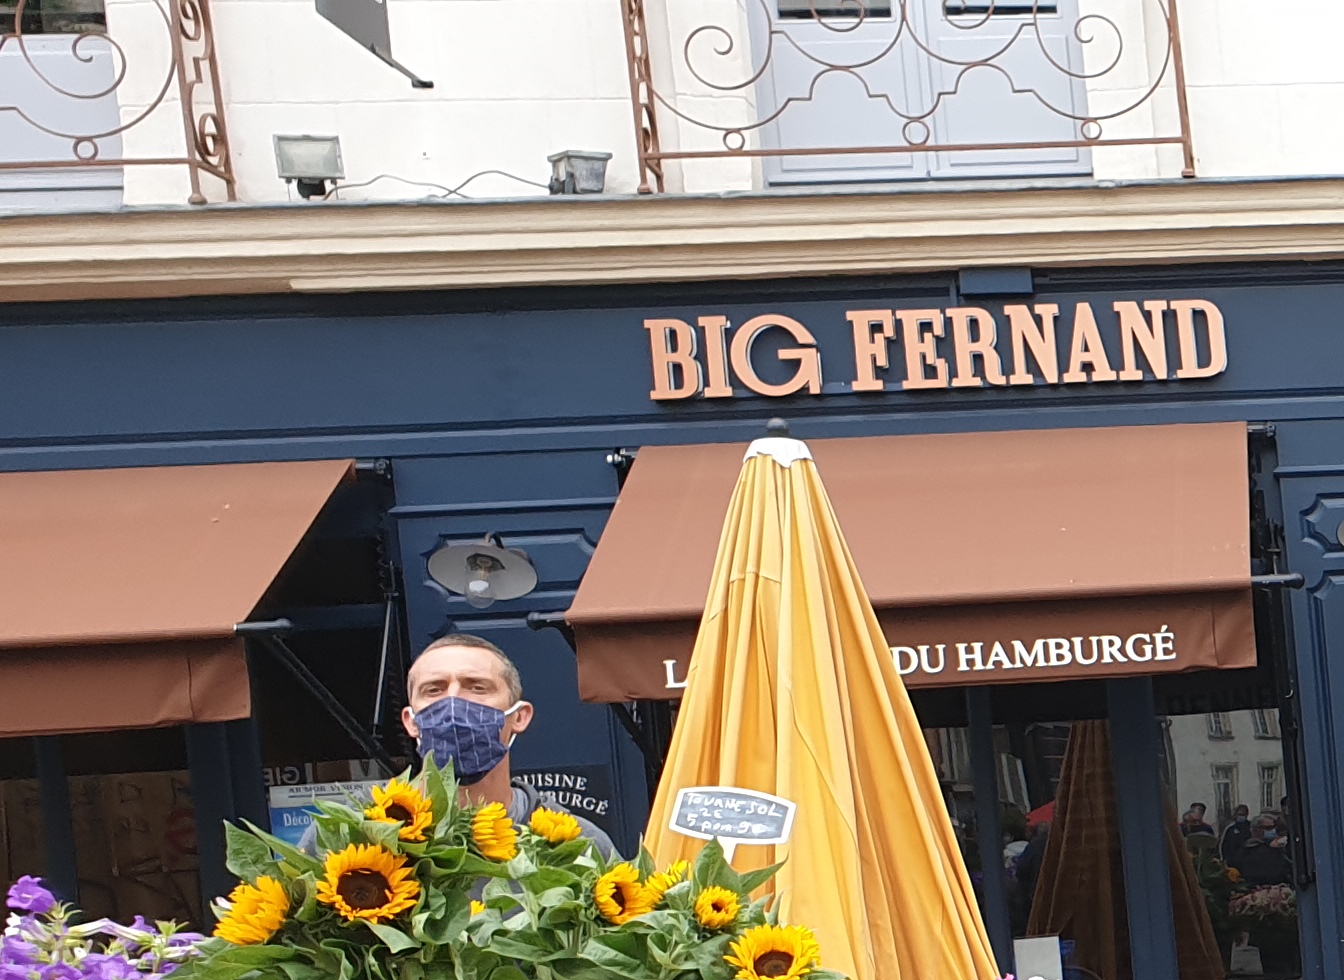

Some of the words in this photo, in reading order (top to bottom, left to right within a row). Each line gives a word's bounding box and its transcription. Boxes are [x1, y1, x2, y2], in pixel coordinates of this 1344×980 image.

[644, 313, 822, 401] BIG
[845, 298, 1229, 392] FERNAND
[957, 625, 1177, 673] HAMBURGÉ
